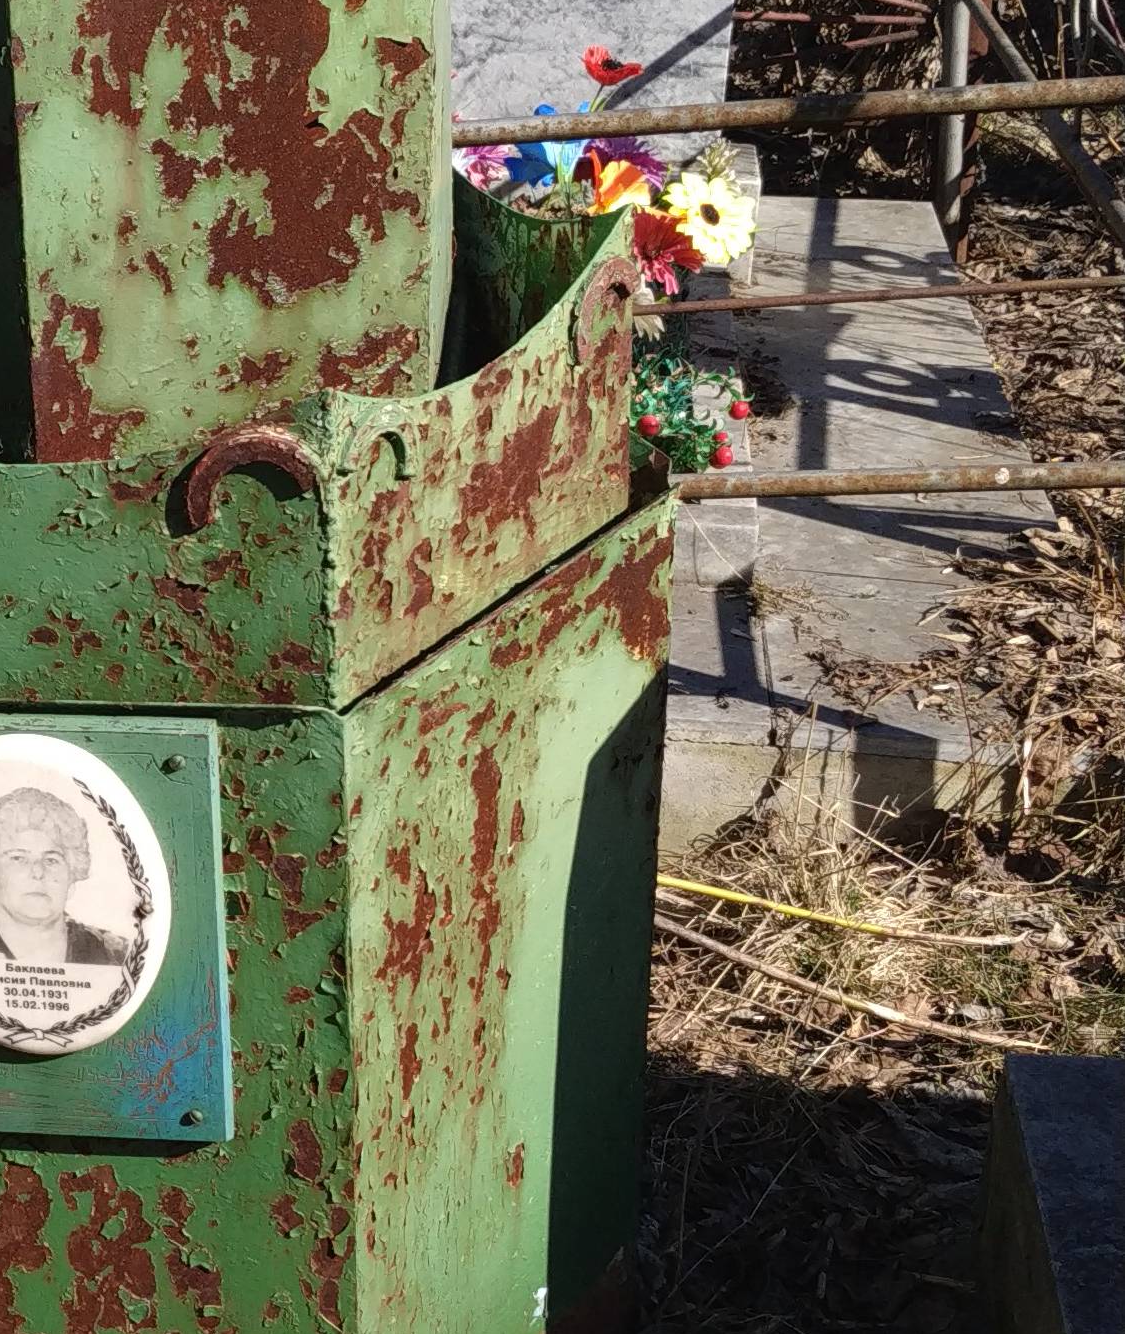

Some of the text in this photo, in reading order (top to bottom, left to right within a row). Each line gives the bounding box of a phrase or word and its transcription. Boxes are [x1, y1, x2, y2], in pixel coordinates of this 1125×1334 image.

[5, 963, 65, 975] Баклаева
[30, 976, 92, 988] Павловна
[4, 987, 68, 999] 30.04.1931
[5, 999, 70, 1011] 15.02.1996
